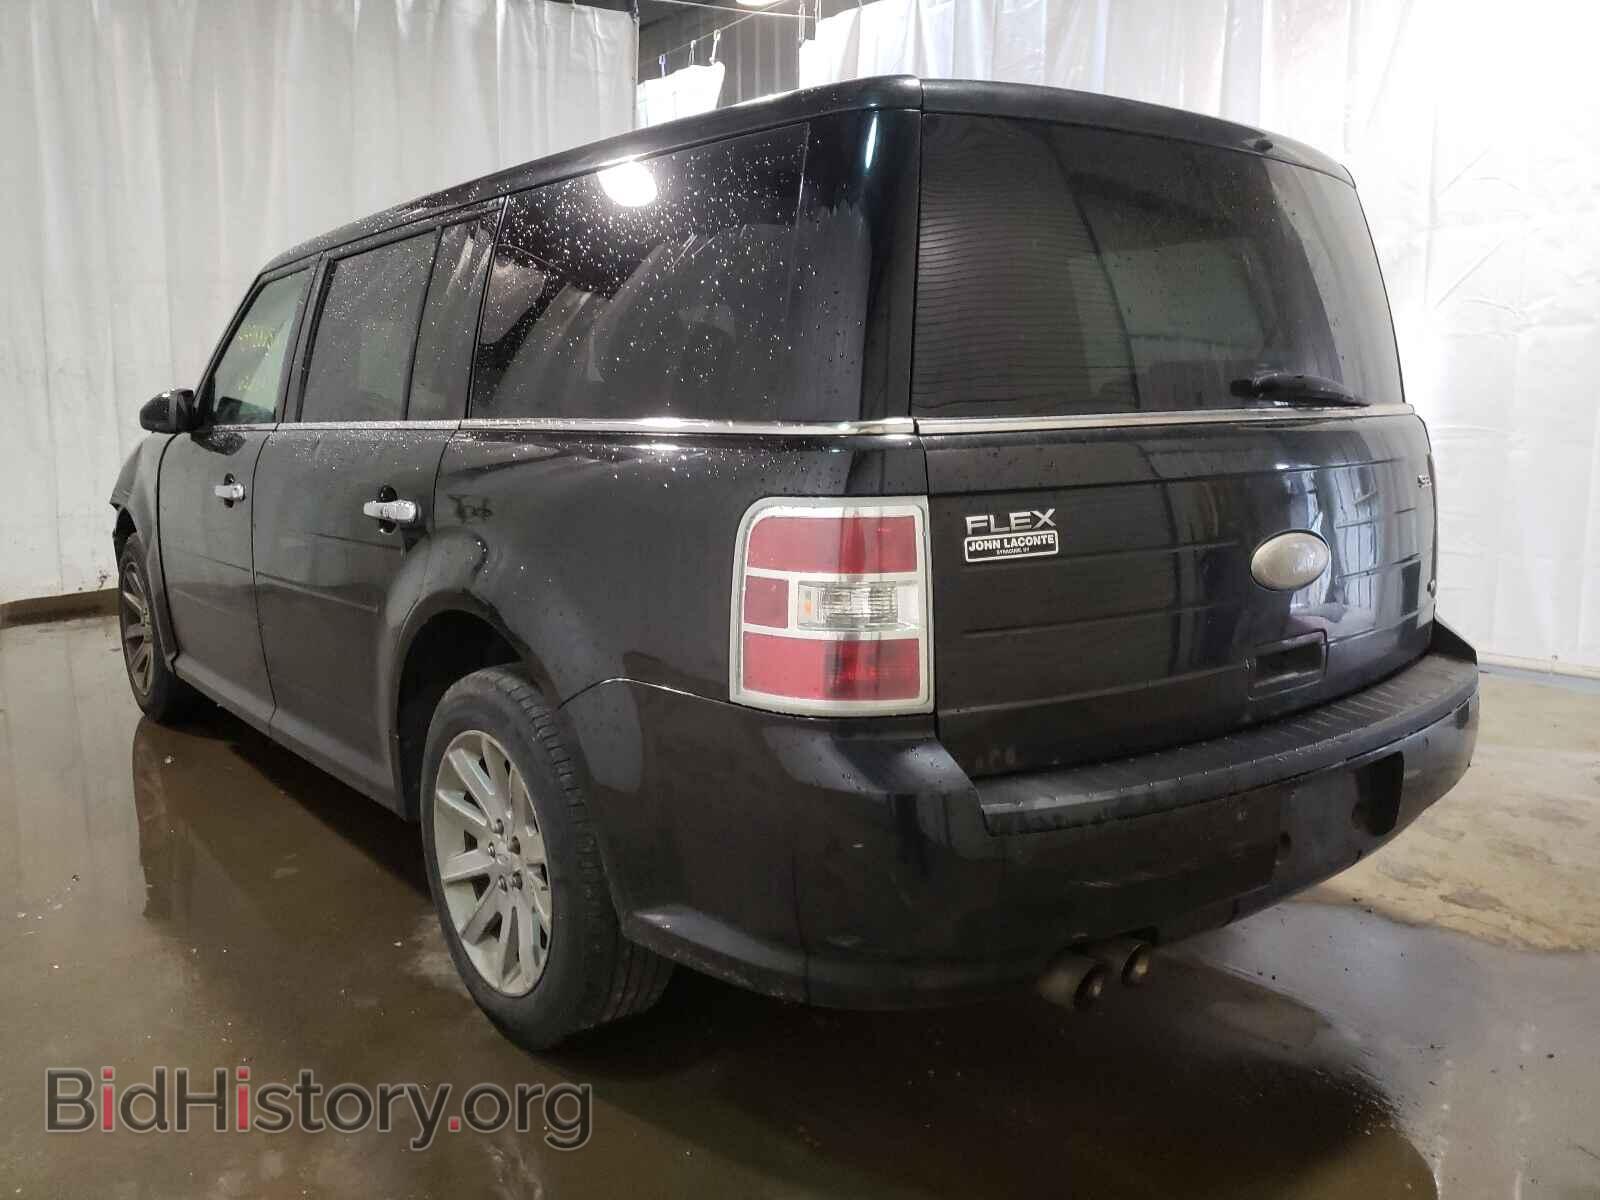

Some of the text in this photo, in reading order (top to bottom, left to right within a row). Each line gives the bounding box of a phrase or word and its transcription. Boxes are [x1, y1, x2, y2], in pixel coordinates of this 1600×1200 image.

[965, 508, 1056, 535] FLEX
[968, 541, 1001, 551] JOHN
[1003, 535, 1055, 548] LACONTE
